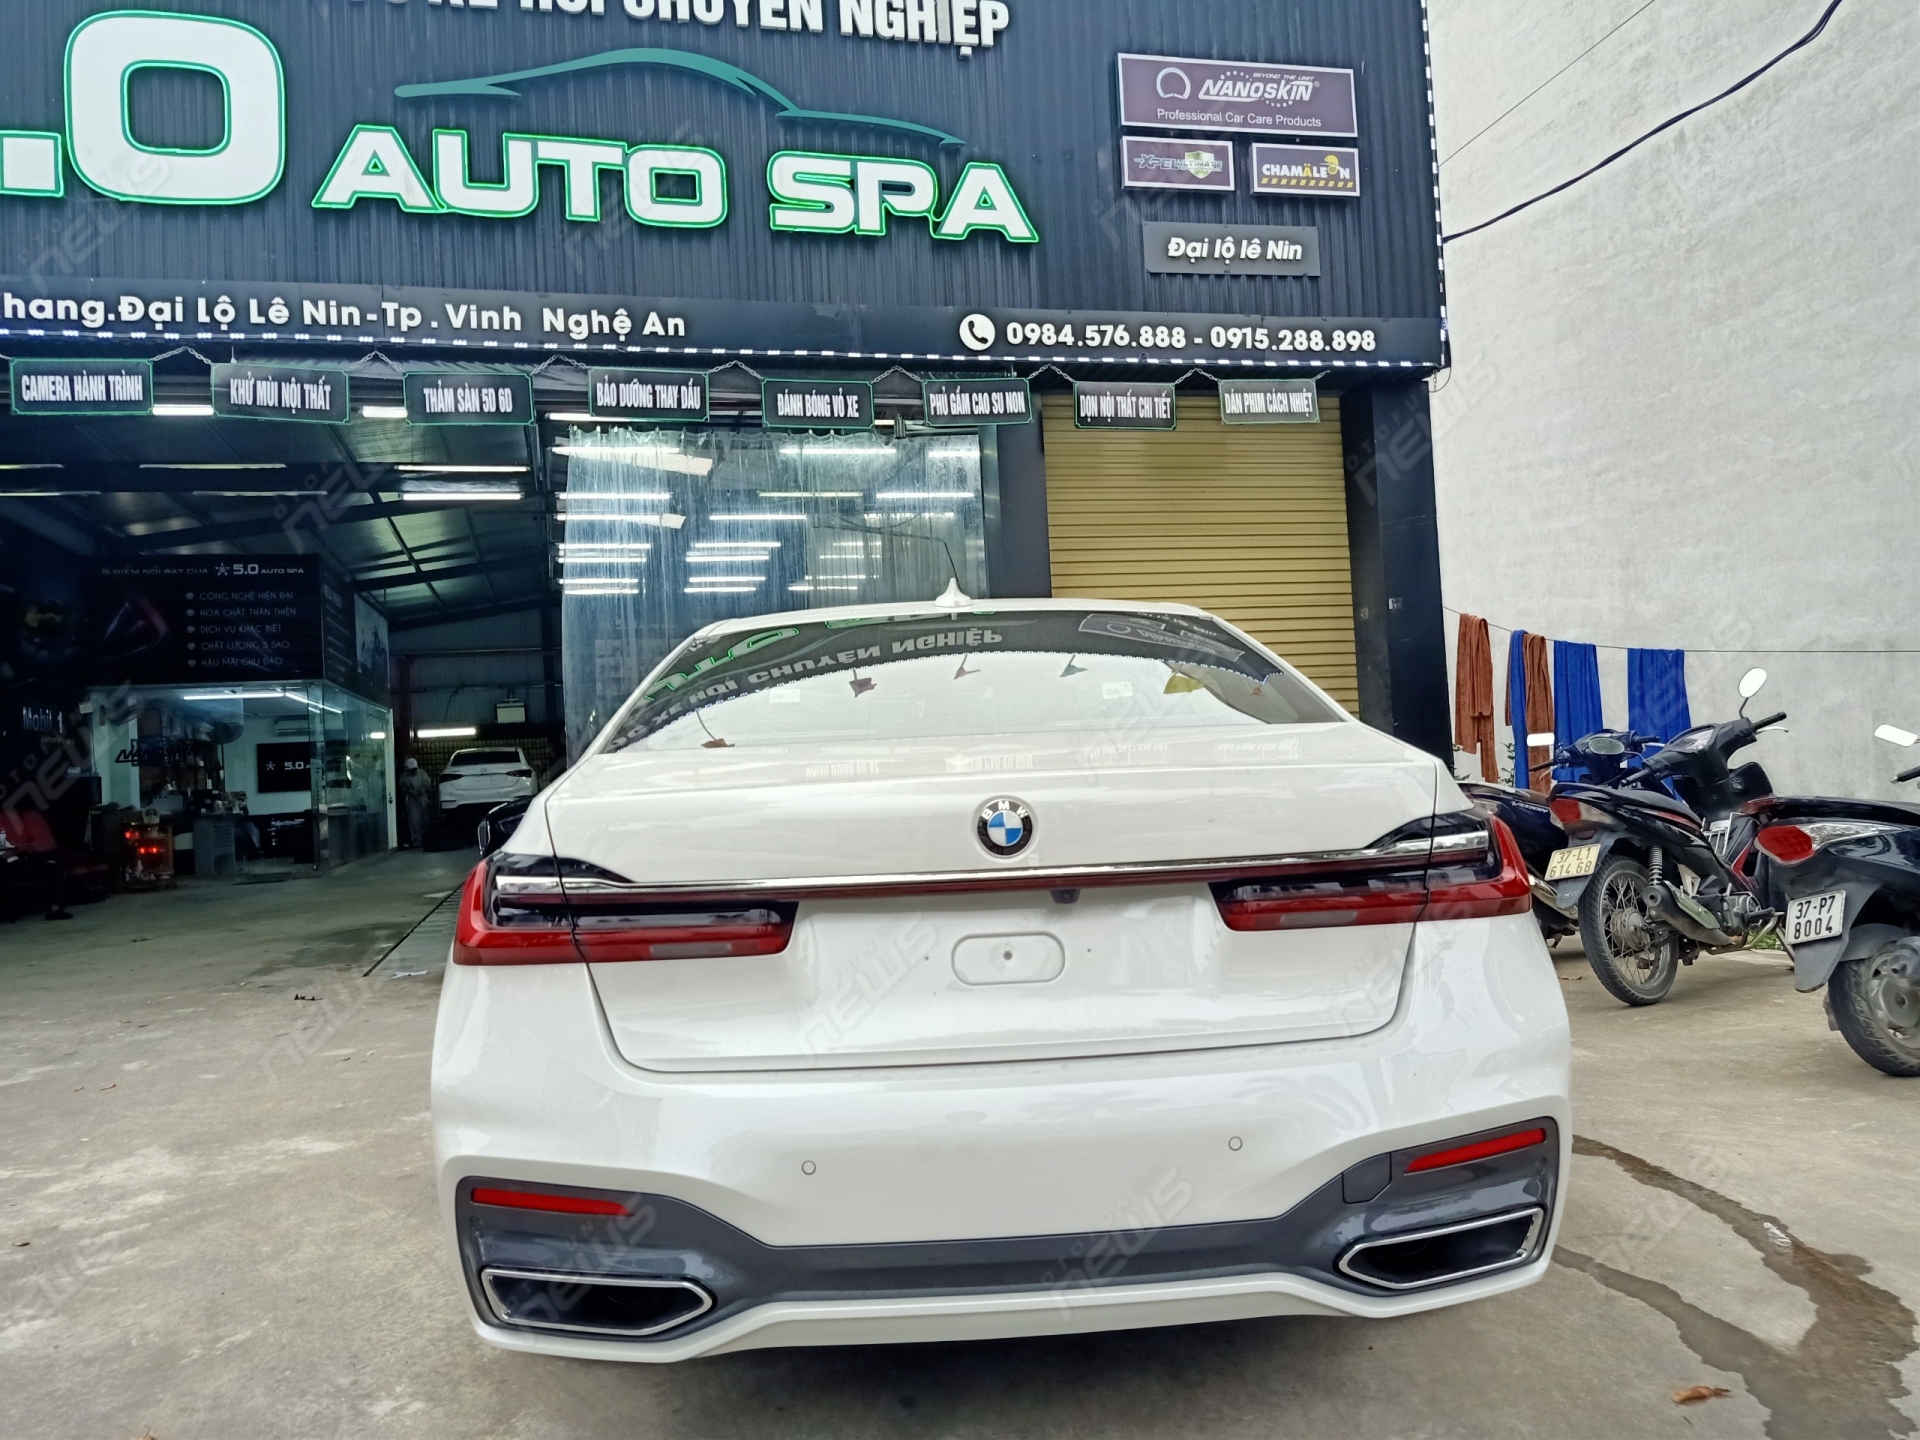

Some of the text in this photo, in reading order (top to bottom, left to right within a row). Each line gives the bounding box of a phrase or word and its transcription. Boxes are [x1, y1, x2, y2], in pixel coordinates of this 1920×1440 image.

[1198, 79, 1314, 102] NANOSKIN
[1157, 108, 1322, 128] Professional Car Care Products
[312, 124, 728, 228] AUTO
[767, 151, 1039, 243] SPA
[1167, 235, 1303, 265] Đại lộ lê Nin
[197, 294, 236, 331] Lộ
[250, 296, 290, 325] Lê
[543, 306, 632, 342] Nghệ
[642, 311, 686, 337] An
[1006, 322, 1187, 349] 0984.576.888
[1210, 326, 1376, 352] 0915.288.898
[21, 369, 143, 402] CAMERA HÀNH TRÌNH
[230, 371, 331, 415] KHỬ MÙI NỘI THẤT
[423, 379, 513, 413] THẢM SÀN 5D 6D
[596, 374, 618, 407] BẢO
[619, 378, 653, 408] DƯỠNG
[654, 384, 679, 409] THAY
[777, 387, 859, 418] ĐÁNH BÓNG VỎ XE
[930, 385, 948, 416] PHỦ
[972, 392, 990, 415] CAO
[991, 391, 1004, 415] SU
[1005, 391, 1026, 414] NON
[1080, 388, 1171, 423] DỌN NỘI THẤT CHI TIẾT
[1224, 387, 1313, 418] DÁN PHIM CÁCH NHIỆT
[232, 563, 304, 576] 5.0 AUTO SPA
[199, 590, 229, 601] CÔNG
[279, 591, 294, 602] ĐẠI
[222, 606, 246, 617] CHẤT
[248, 606, 271, 617] THÂN
[273, 606, 297, 618] THIỆN
[200, 625, 221, 635] DỊCH
[223, 625, 236, 635] VỤ
[265, 623, 282, 634] BIỆT
[270, 640, 290, 650] SAO
[284, 761, 304, 770] 5.0
[981, 800, 1029, 820] BMW
[1556, 847, 1591, 864] 37-L1
[1549, 860, 1592, 878] 614.68
[1795, 894, 1836, 920] 37-P7
[1793, 915, 1833, 940] 8004
